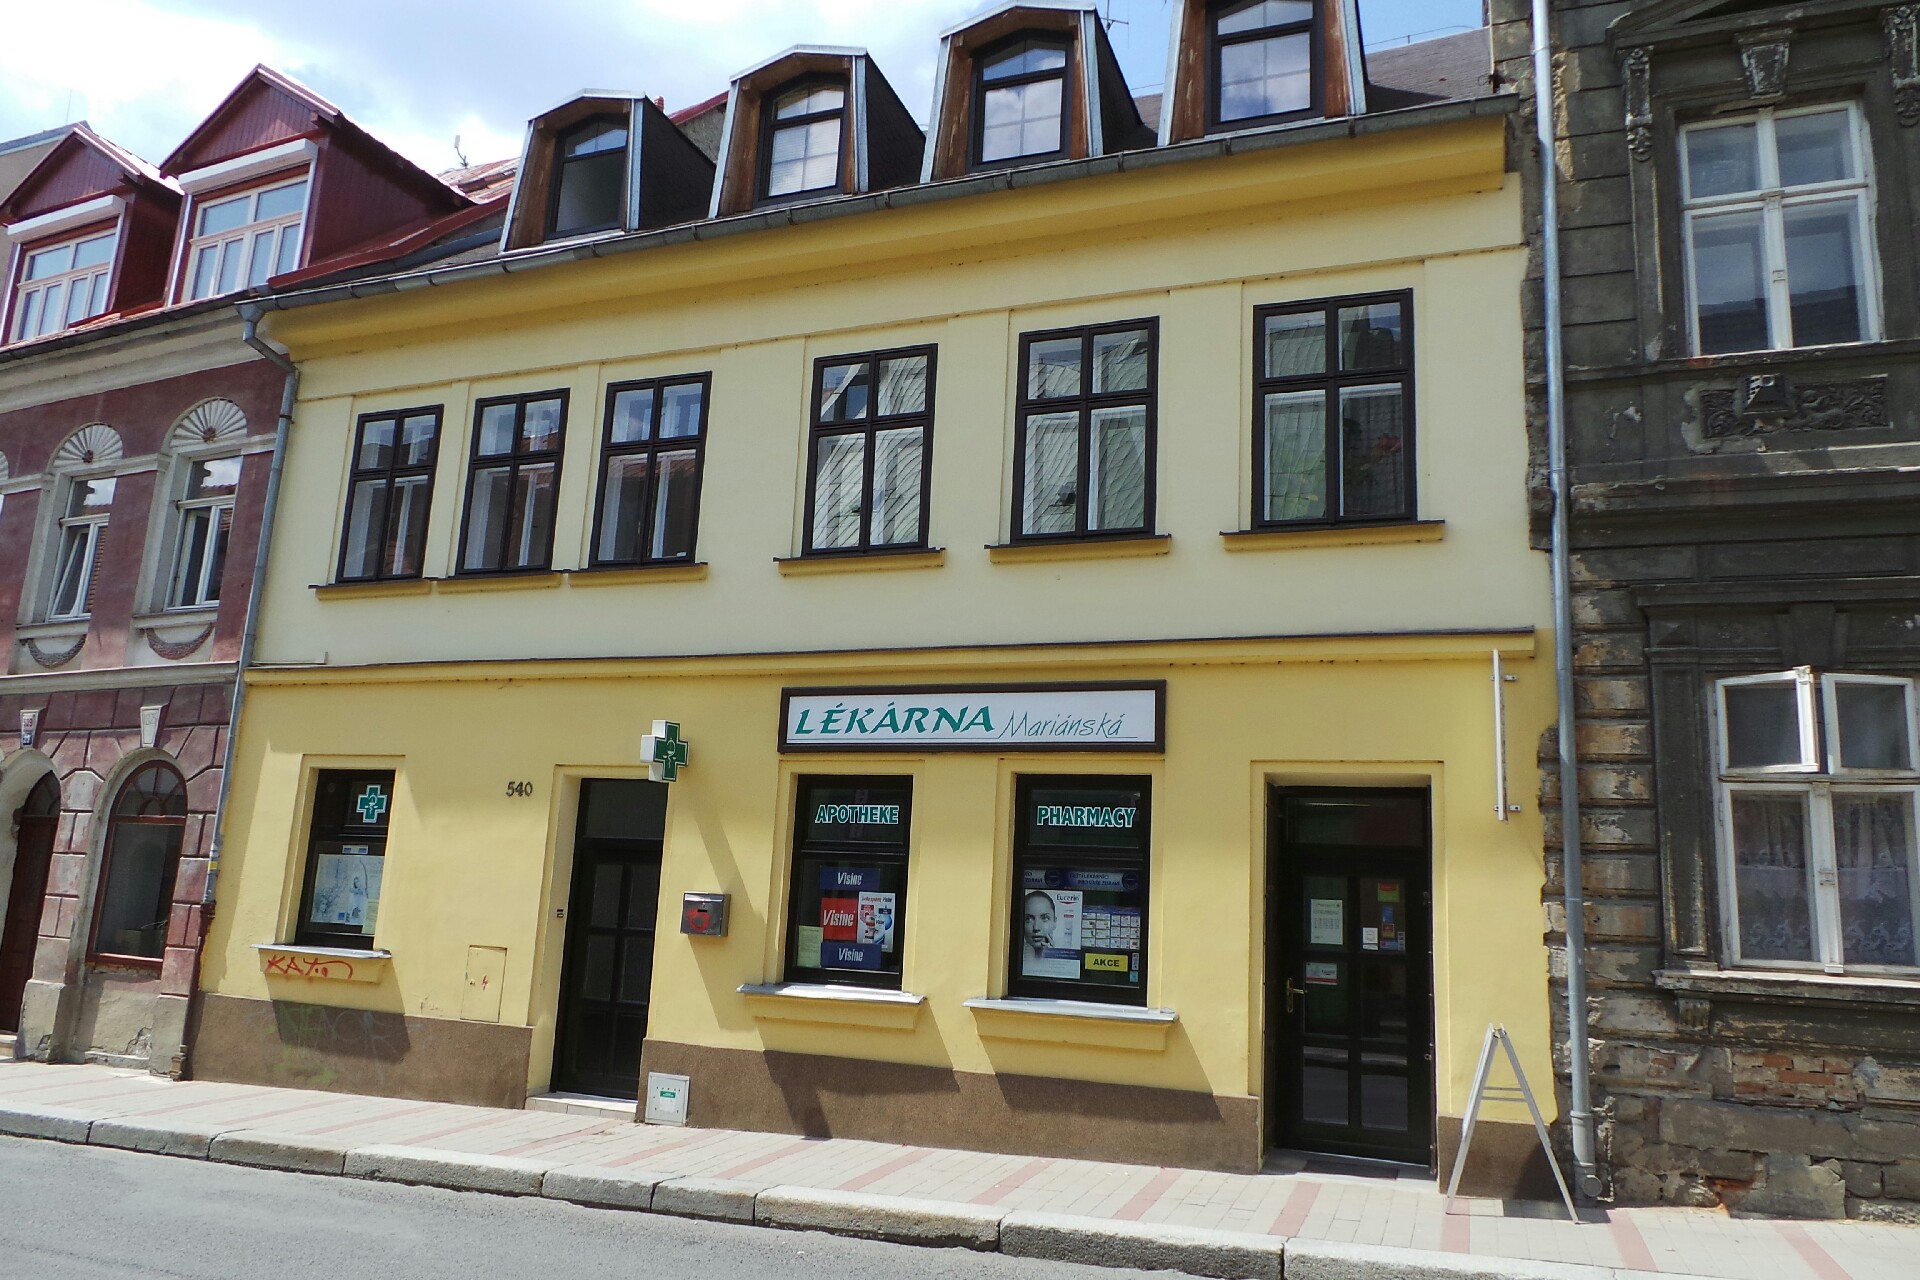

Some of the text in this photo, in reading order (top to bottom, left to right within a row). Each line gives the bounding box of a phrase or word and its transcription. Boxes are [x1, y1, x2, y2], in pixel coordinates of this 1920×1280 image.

[795, 701, 1126, 739] LÉKÁRNA Mariánská
[505, 781, 533, 797] 540
[815, 804, 899, 824] APOTHEKE
[1036, 805, 1136, 828] PHARMACY
[837, 872, 862, 886] Visine
[1056, 893, 1080, 901] Eucerin
[823, 909, 854, 927] Visine
[838, 947, 864, 962] Visine
[1092, 958, 1121, 968] AKCE
